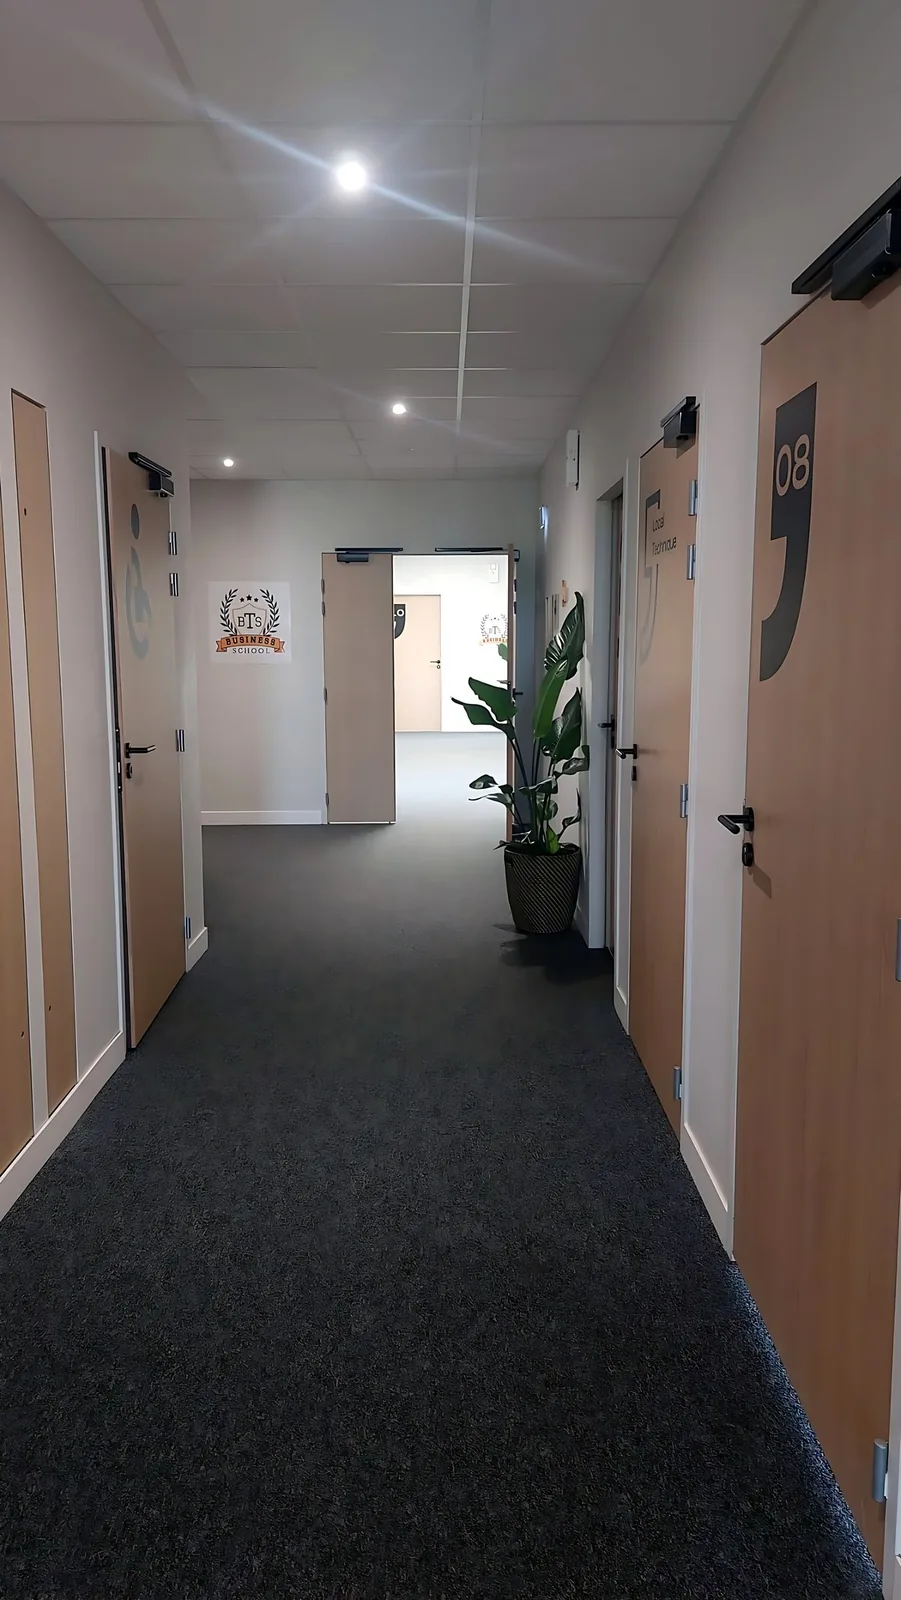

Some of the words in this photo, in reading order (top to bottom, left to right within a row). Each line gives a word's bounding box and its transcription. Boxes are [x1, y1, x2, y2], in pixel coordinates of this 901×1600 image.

[776, 434, 810, 496] 08
[237, 613, 262, 629] BTS
[226, 636, 276, 646] BUSINESS
